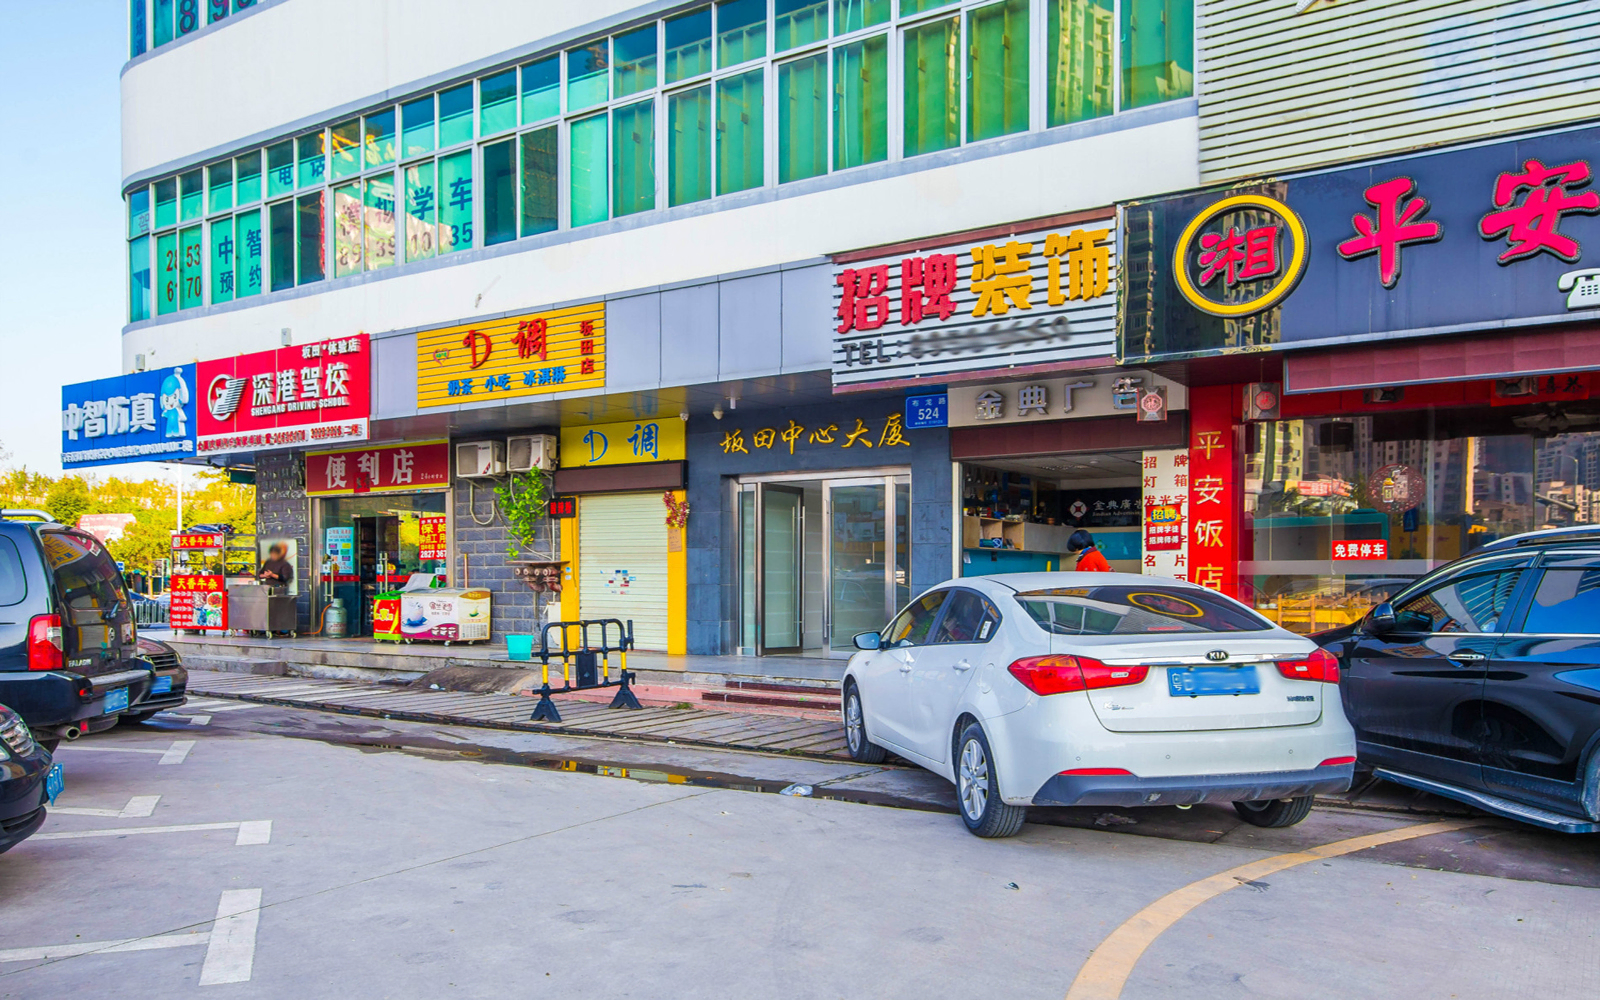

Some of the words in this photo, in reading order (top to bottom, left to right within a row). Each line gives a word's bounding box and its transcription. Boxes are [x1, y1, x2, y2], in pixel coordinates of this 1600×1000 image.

[1337, 158, 1600, 288] 平安
[218, 228, 262, 265] 中智
[1199, 226, 1280, 287] 湘
[166, 276, 202, 302] 670
[219, 264, 262, 294] 预约
[837, 228, 1110, 334] 招牌装饰
[251, 361, 350, 407] 深港驾校
[447, 377, 474, 397] 奶茶
[484, 373, 512, 393] 小吃
[522, 365, 566, 386] 冰淇淋
[287, 399, 318, 413] DRIVING
[318, 396, 350, 409] SCHOOL
[918, 407, 940, 420] 524
[975, 376, 1144, 421] 金典广告
[61, 392, 156, 441] 中智仿真
[719, 412, 911, 455] 坂田中心大厦
[325, 449, 415, 489] 便利店
[1144, 454, 1188, 469] 招牌
[1144, 474, 1188, 489] 灯箱
[1144, 494, 1188, 508] 发光字
[1151, 508, 1177, 521] 招聘
[1193, 430, 1225, 592] 平安饭店
[1148, 525, 1180, 535] 招牌学徒
[1144, 554, 1187, 568] 名片
[1334, 544, 1386, 558] 免费停车
[1209, 651, 1226, 660] KIA
